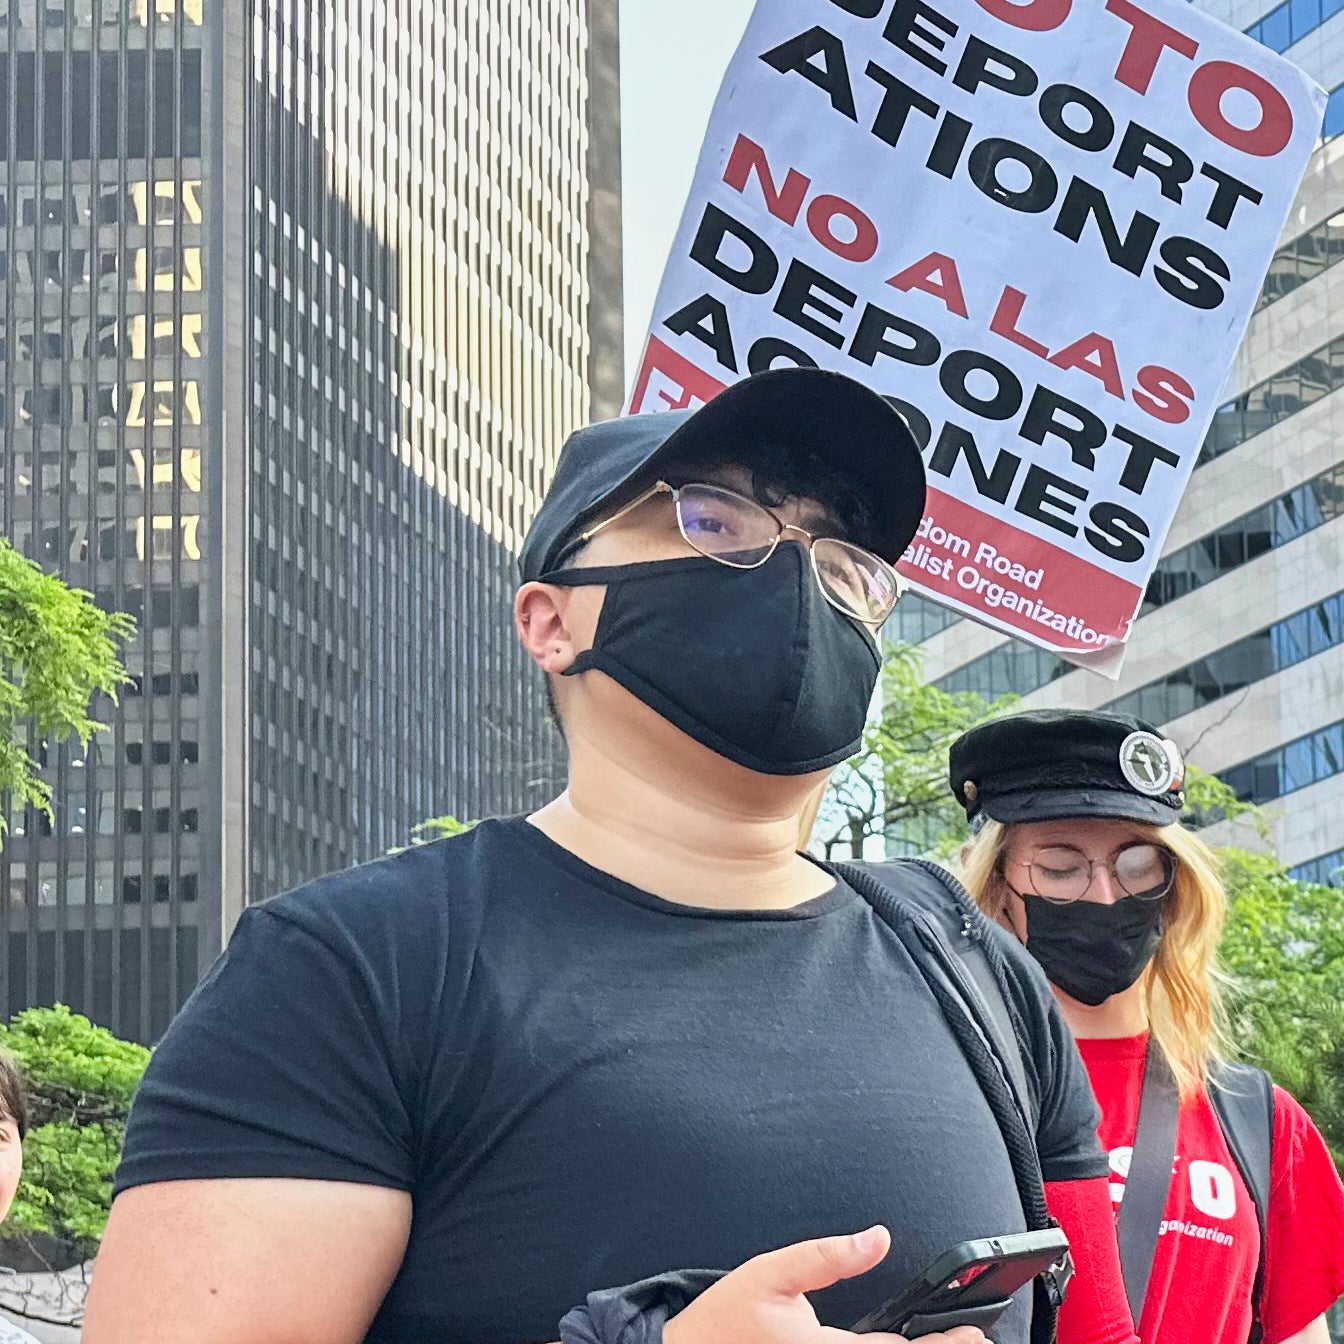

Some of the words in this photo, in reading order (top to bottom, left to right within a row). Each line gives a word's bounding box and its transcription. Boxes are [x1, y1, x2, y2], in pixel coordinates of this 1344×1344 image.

[758, 25, 1232, 310] ATIONS
[829, 0, 1262, 231] EPORT
[1103, 0, 1294, 157] TO
[689, 202, 1178, 495] DEPORT
[722, 133, 879, 263] NO
[885, 251, 970, 319] A
[989, 285, 1195, 424] LAS
[900, 543, 954, 581] alist
[956, 566, 1112, 649] Organization
[916, 516, 970, 558] dom
[973, 542, 1044, 591] Road
[1158, 1219, 1234, 1247] ganization
